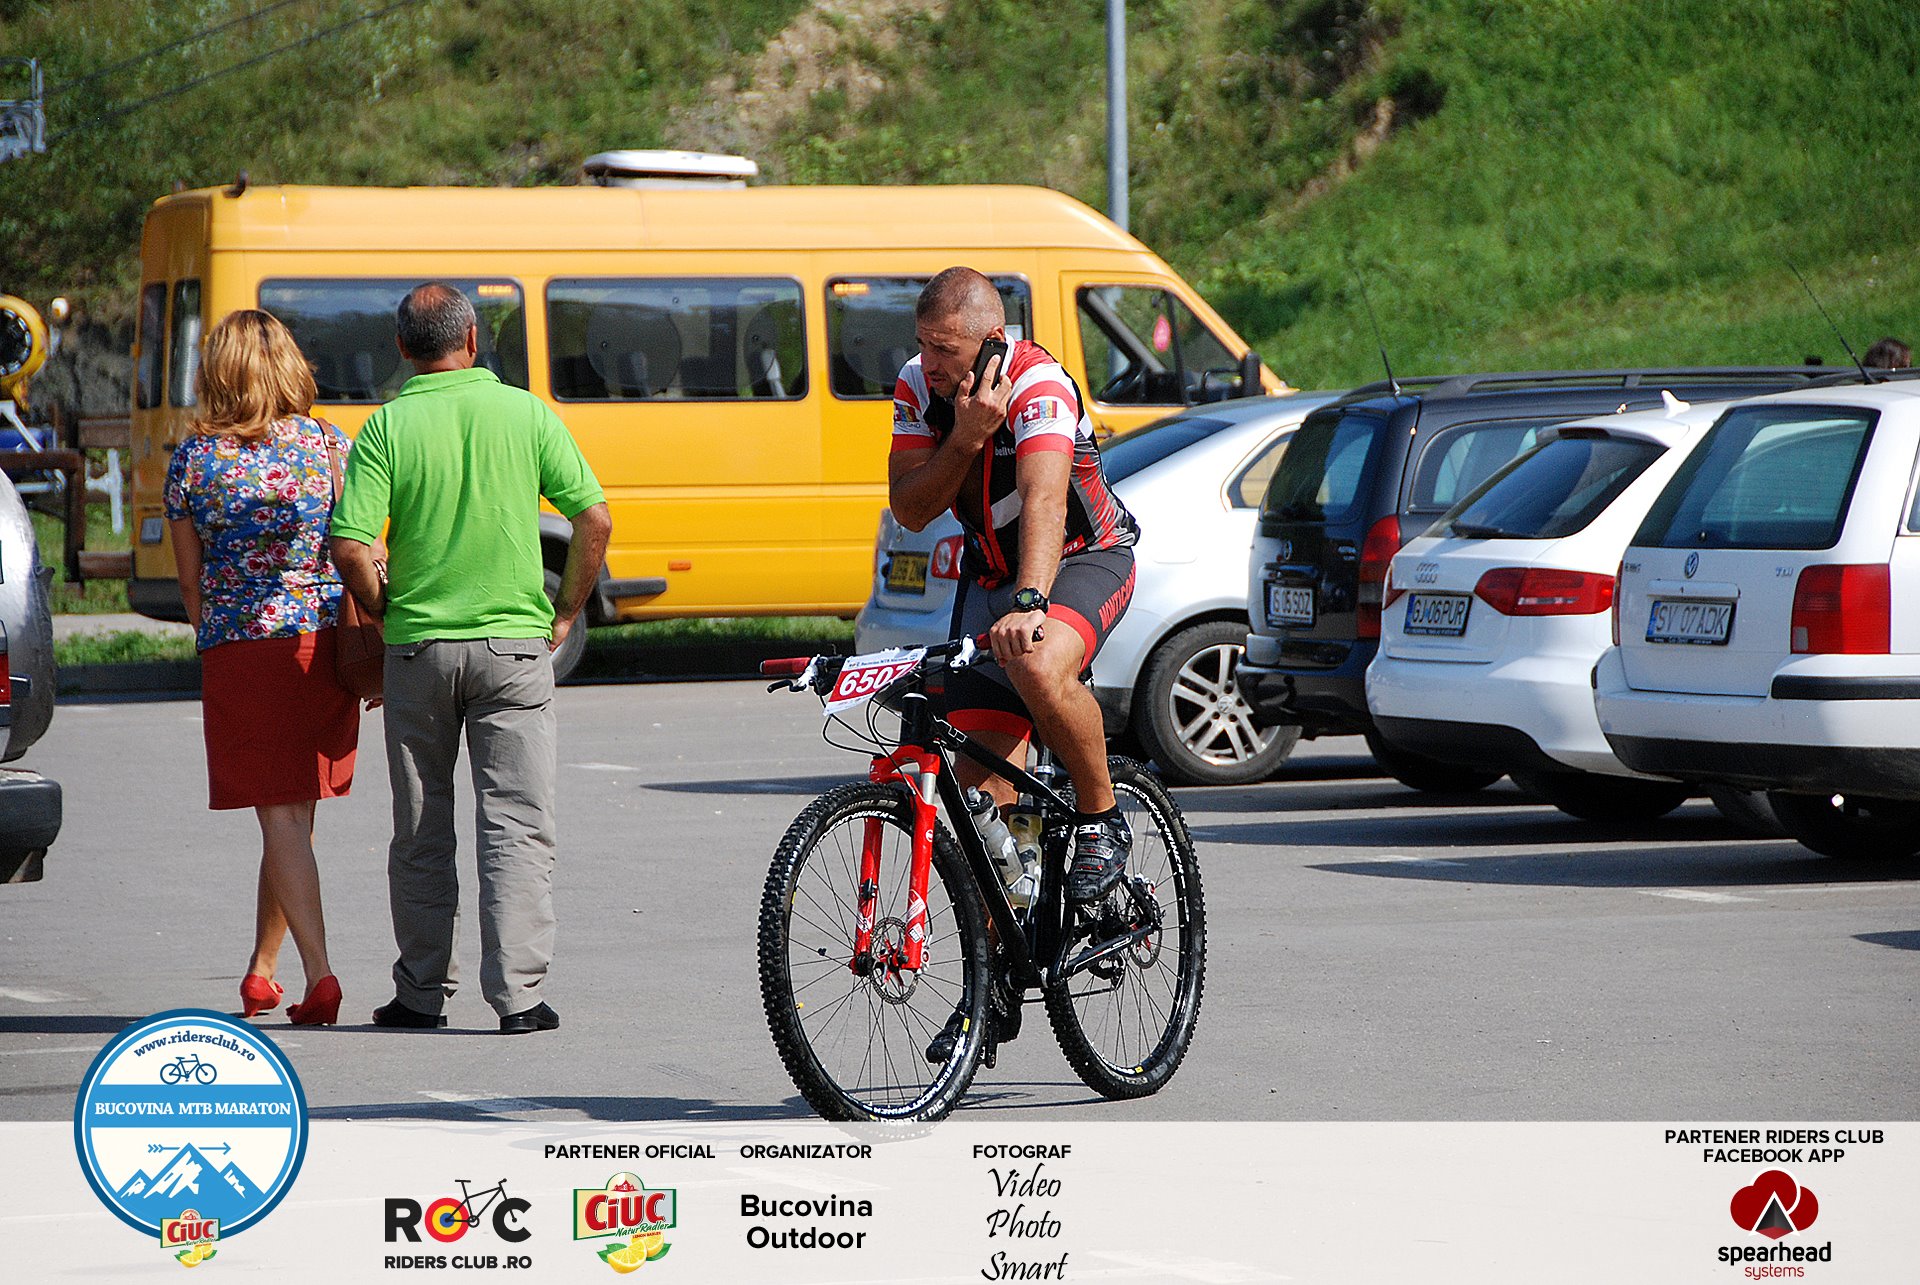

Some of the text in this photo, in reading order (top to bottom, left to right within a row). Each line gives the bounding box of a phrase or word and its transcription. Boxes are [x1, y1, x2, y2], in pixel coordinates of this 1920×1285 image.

[1412, 599, 1466, 625] GJ 06 PUR
[1656, 605, 1730, 636] SV 07 ADK
[838, 662, 913, 697] 6507
